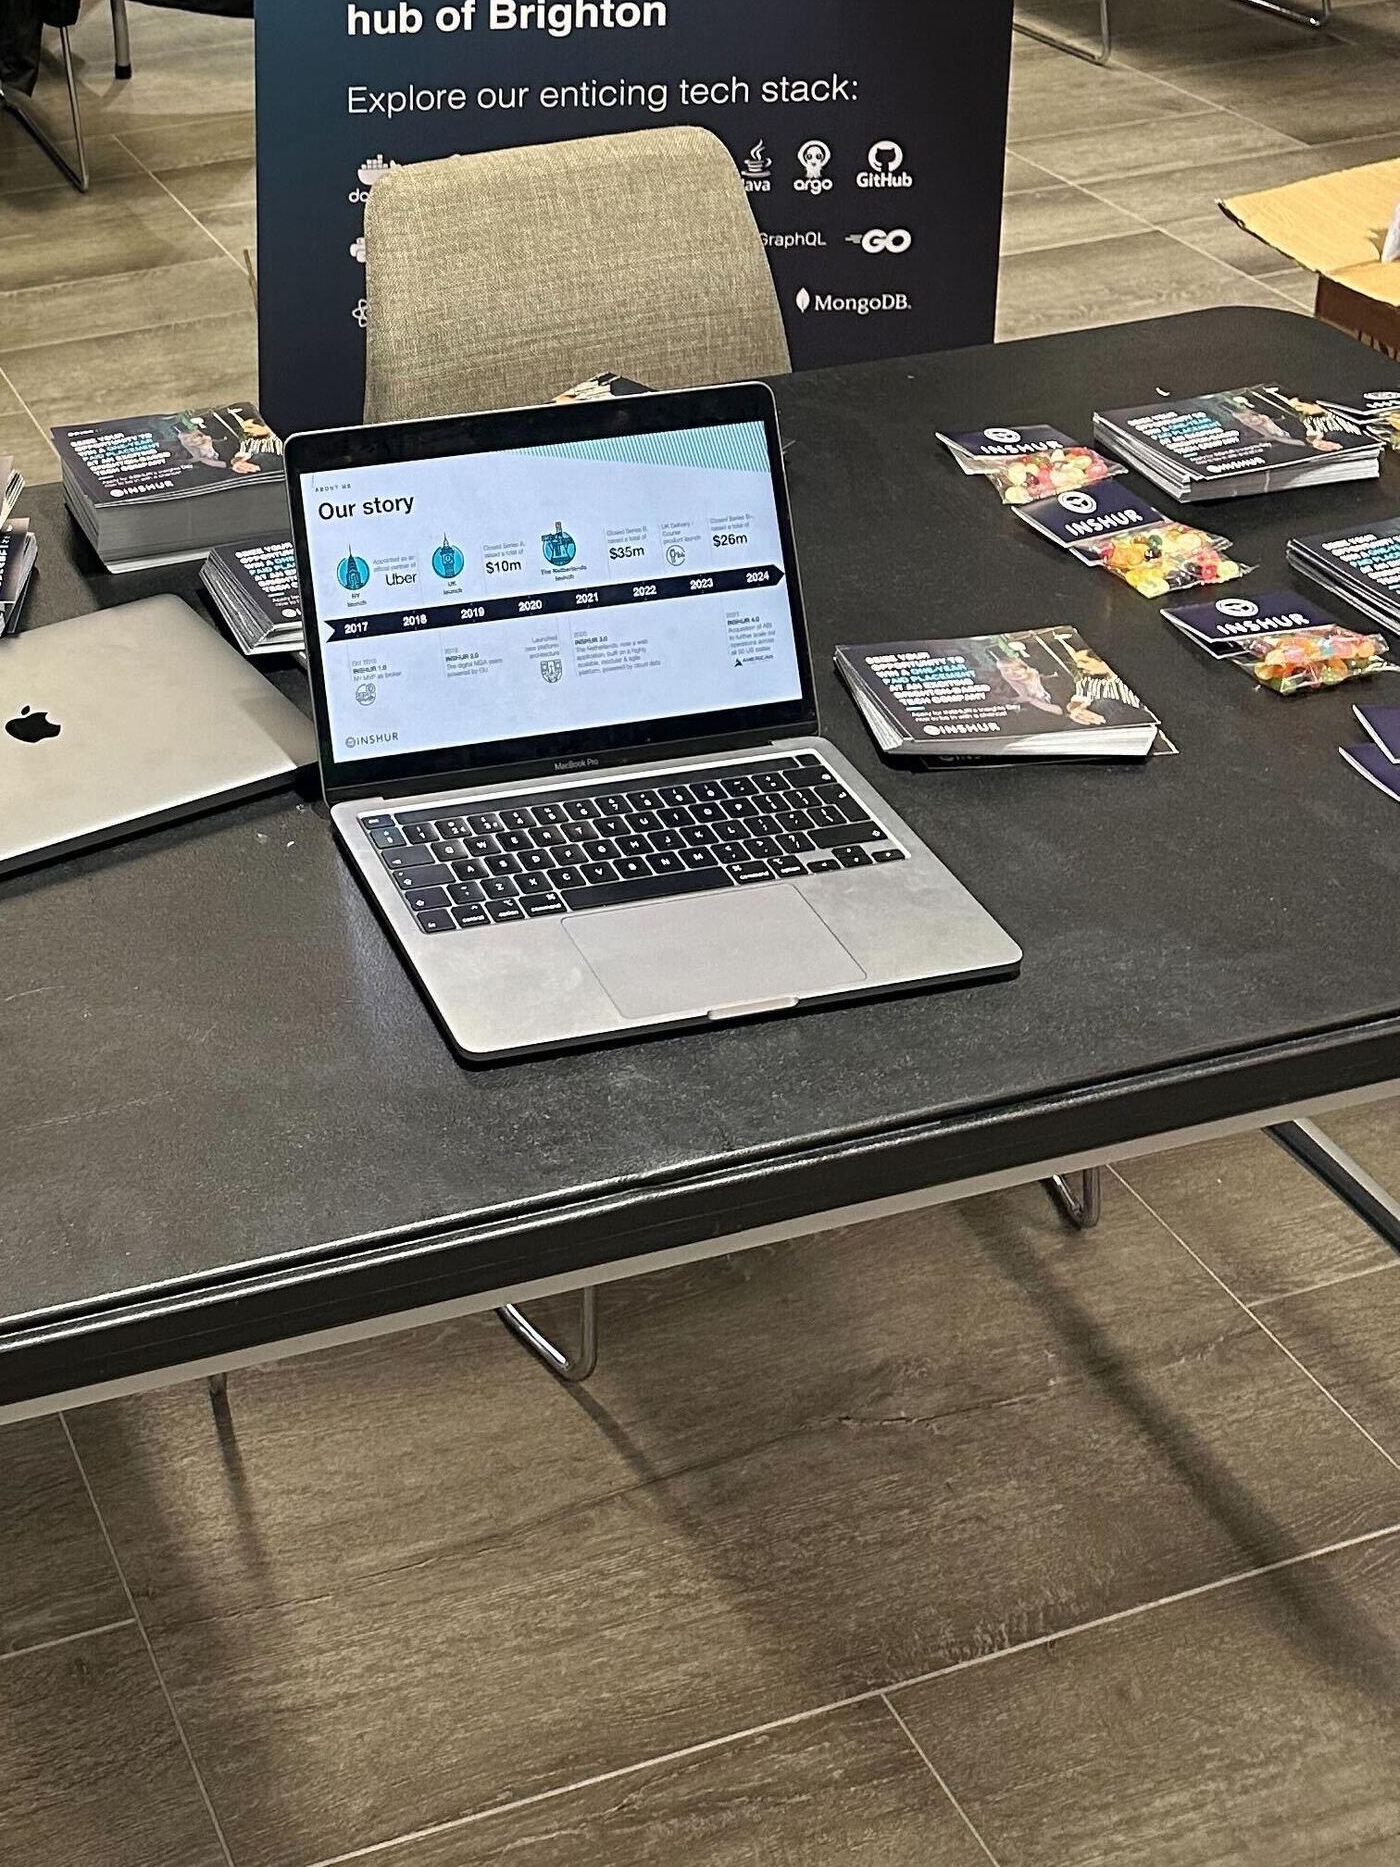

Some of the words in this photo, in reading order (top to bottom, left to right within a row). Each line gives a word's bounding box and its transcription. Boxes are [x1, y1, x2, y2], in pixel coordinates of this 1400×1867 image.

[347, 1, 423, 35] hub
[348, 84, 467, 117] Explore
[477, 87, 529, 109] our
[540, 79, 667, 110] enticing
[679, 76, 749, 105] tech
[761, 73, 858, 103] stack:
[793, 178, 833, 195] argo
[856, 171, 913, 188] GitHub
[861, 228, 912, 253] GO
[318, 502, 356, 520] Our
[362, 496, 414, 515] story
[1064, 509, 1144, 537] INSHUR
[712, 533, 748, 548] $26m
[609, 546, 645, 560] $35m
[485, 560, 522, 574] $10m
[385, 573, 417, 586] Uber
[344, 621, 369, 635] 2017
[402, 614, 428, 627] 2018
[460, 606, 485, 620] 2019
[517, 599, 543, 612] 2020
[575, 592, 599, 605] 2021
[632, 585, 657, 597] 2022
[689, 577, 714, 590] 2023
[745, 571, 770, 583] 2024
[1217, 613, 1310, 636] INSHUR
[356, 732, 399, 746] INSHUR
[554, 759, 586, 771] MacBook
[586, 758, 599, 766] Pro
